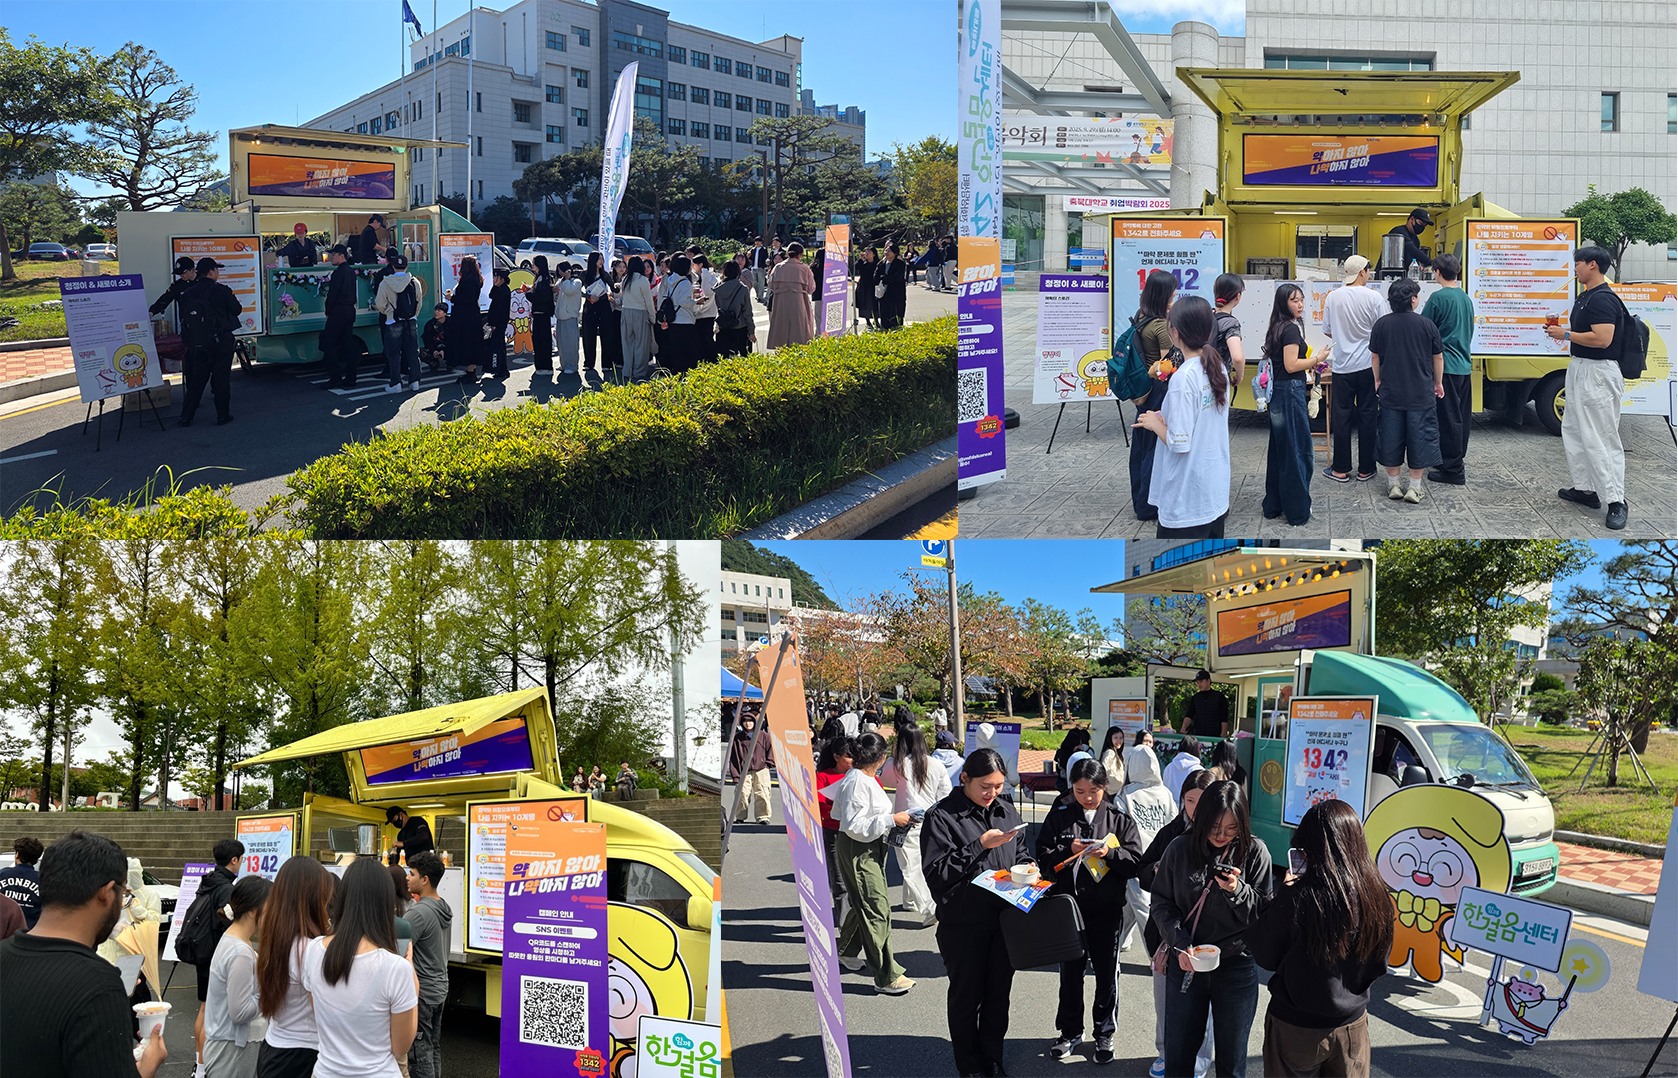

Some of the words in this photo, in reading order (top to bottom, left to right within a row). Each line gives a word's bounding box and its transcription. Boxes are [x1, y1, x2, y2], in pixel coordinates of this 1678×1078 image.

[1312, 147, 1345, 162] 약하지
[1346, 144, 1370, 158] 않아
[1310, 159, 1349, 176] 나약하지
[1350, 155, 1370, 169] 않아
[1069, 198, 1108, 207] 충북대학교
[1110, 199, 1148, 208] 취업박람회
[1150, 200, 1170, 209] 2025
[962, 264, 996, 282] 않아
[1136, 268, 1199, 290] 142
[89, 280, 96, 288] &
[969, 276, 998, 296] 않아
[1045, 279, 1069, 288] 청정이
[1071, 280, 1079, 288] &
[1080, 280, 1104, 289] 새로이
[1257, 615, 1279, 631] 약하지
[1279, 609, 1295, 624] 않아
[1282, 619, 1297, 635] 않아
[412, 742, 438, 760] 약하지
[440, 736, 459, 753] 않아
[413, 754, 444, 772] 나약하지
[445, 746, 462, 763] 않아
[1303, 747, 1348, 771] 1342
[477, 814, 490, 822] 나를
[512, 813, 536, 821] 10계명
[246, 855, 278, 873] 1342
[512, 859, 562, 878] 약하지
[564, 854, 601, 873] 않아
[508, 876, 569, 896] 나약하지
[570, 869, 603, 890] 않아
[5, 890, 31, 902] UNIV.
[538, 909, 559, 918] 캠페인
[1488, 905, 1499, 916] 함께
[536, 926, 552, 934] SNS
[553, 927, 573, 935] 이벤트
[1463, 902, 1559, 946] 한걸음센터
[528, 939, 556, 947] QR코드를
[557, 941, 581, 950] 스캔하여
[551, 948, 575, 957] 시청하고
[508, 951, 526, 960] 따뜻한
[544, 955, 568, 964] 한마디를
[569, 957, 602, 967] 남겨주세요!
[675, 1036, 691, 1047] 함께
[580, 1058, 600, 1068] 1342
[646, 1034, 721, 1078] 한걸음
